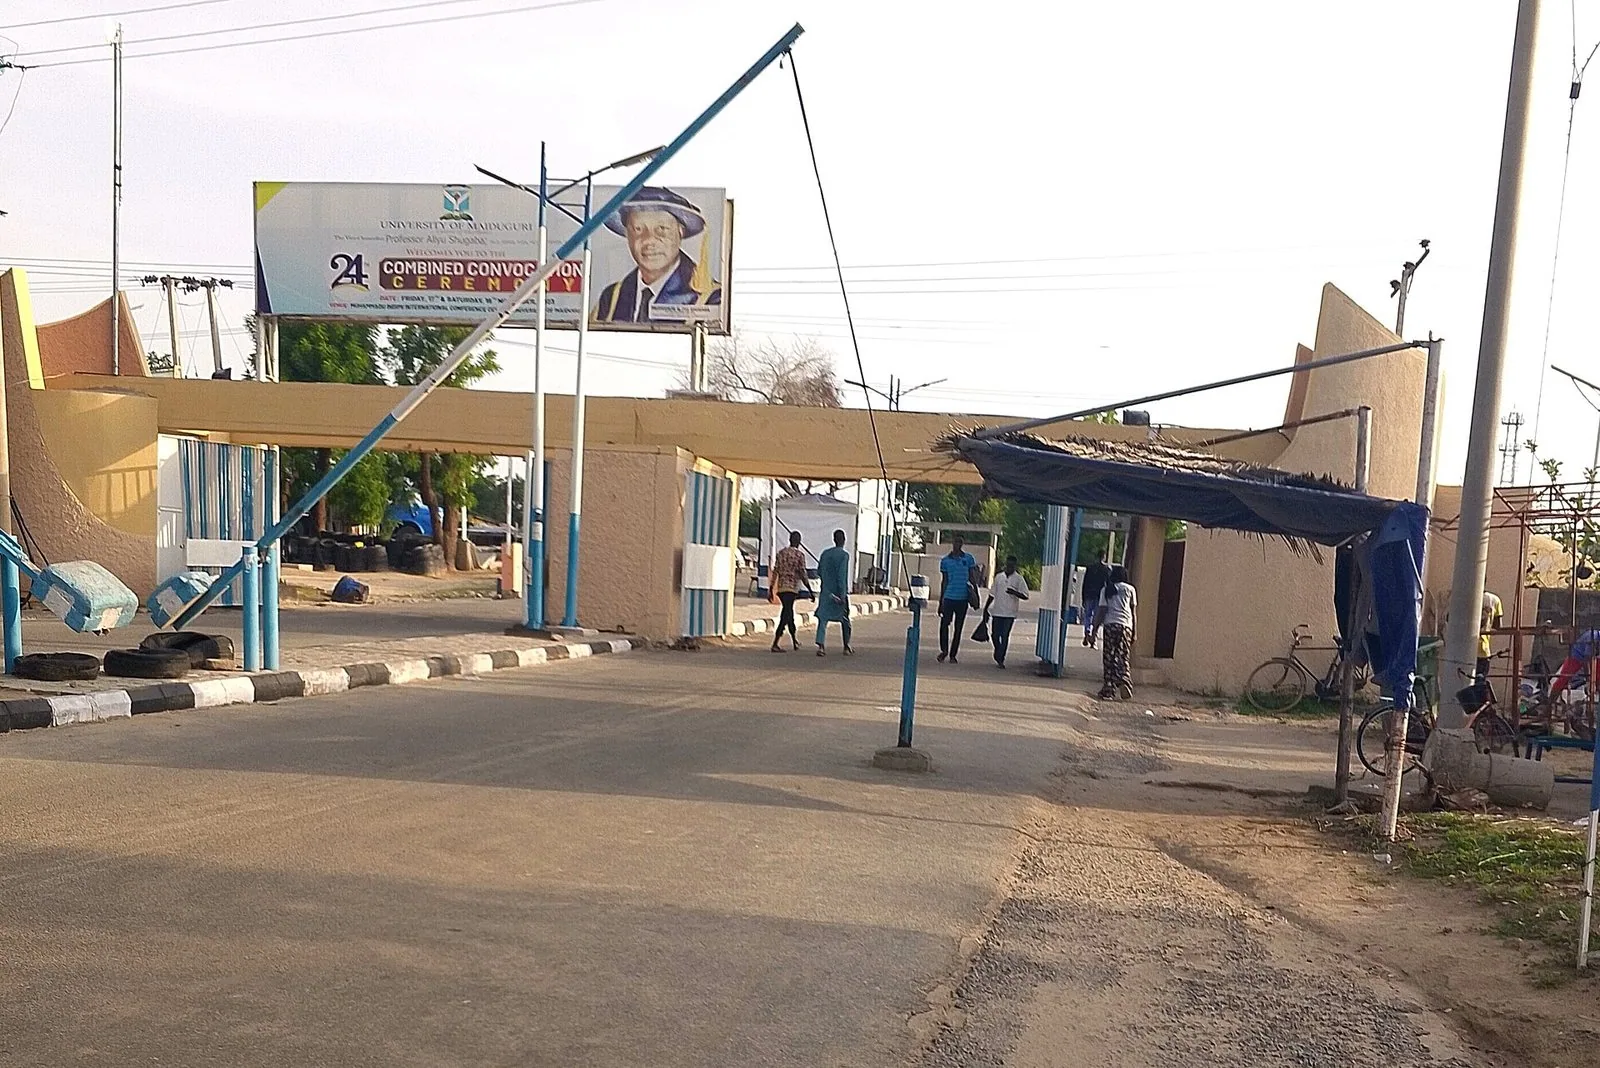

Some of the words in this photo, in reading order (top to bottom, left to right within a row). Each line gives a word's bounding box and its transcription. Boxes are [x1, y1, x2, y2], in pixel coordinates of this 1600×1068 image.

[381, 221, 445, 229] UNIVERSITY
[449, 221, 463, 230] OF
[468, 222, 533, 232] MAIDUGURI
[383, 261, 464, 276] COMBINED
[467, 262, 583, 278] CONVOCION
